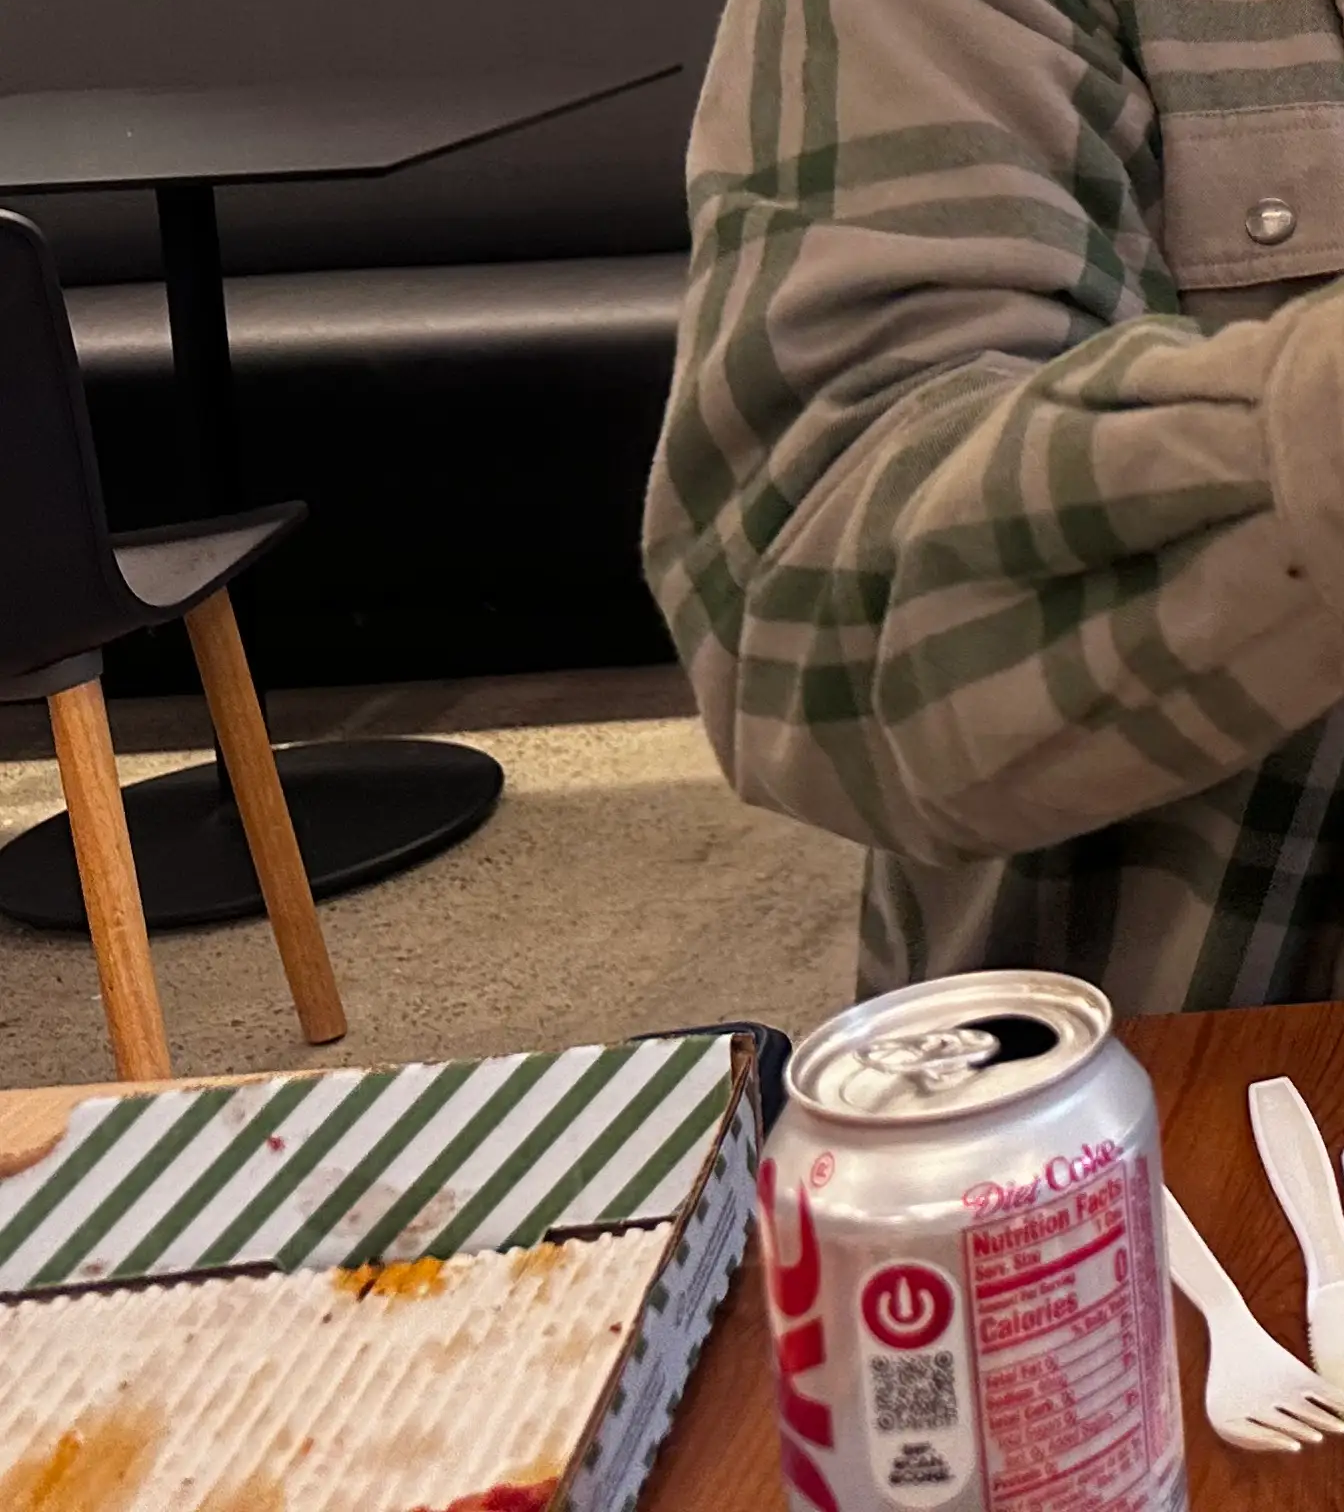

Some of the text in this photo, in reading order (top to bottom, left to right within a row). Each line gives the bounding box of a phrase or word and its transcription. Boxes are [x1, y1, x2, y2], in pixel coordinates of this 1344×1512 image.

[961, 1175, 1040, 1217] Diet
[973, 1179, 1121, 1256] Nutrition Facts
[1114, 1247, 1128, 1283] 0
[979, 1292, 1078, 1344] Calories
